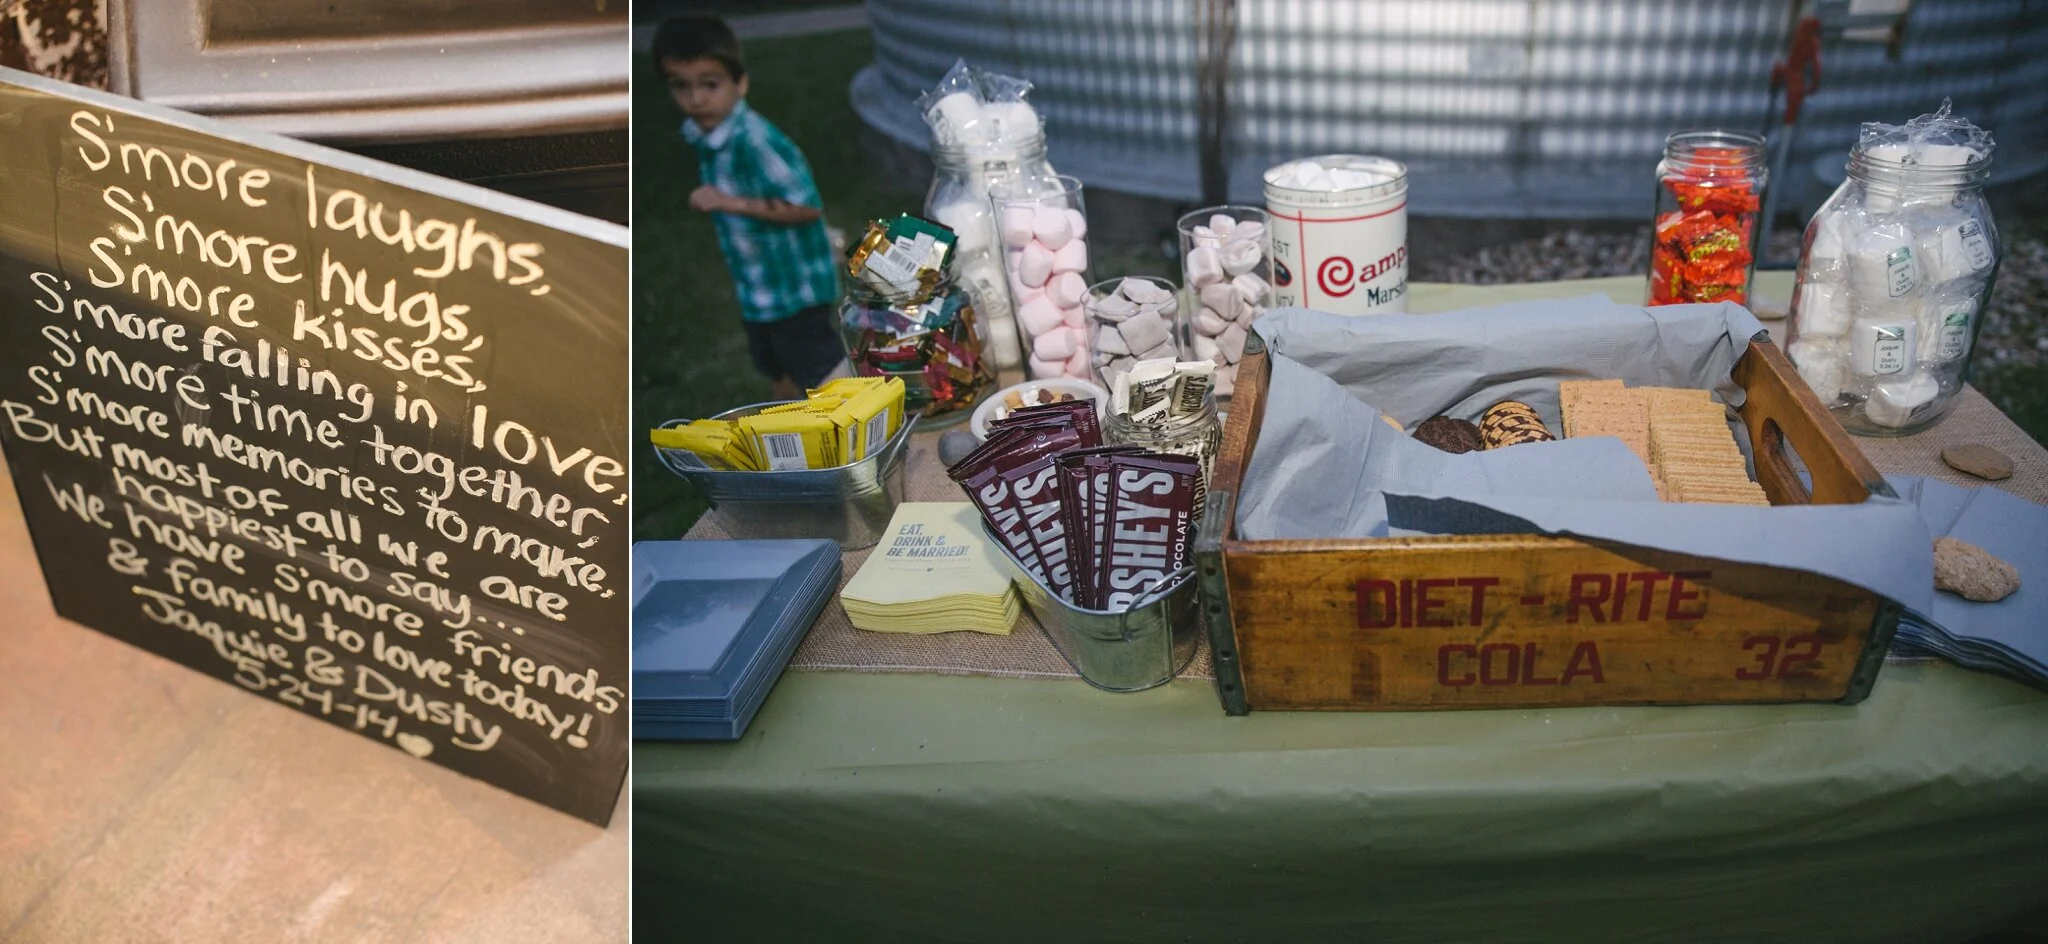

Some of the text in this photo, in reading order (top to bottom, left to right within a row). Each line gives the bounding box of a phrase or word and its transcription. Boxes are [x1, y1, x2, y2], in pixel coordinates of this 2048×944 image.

[70, 110, 551, 296] S'more laughs,
[103, 185, 484, 352] S'more hugs,
[1316, 241, 1408, 298] Camp
[88, 237, 487, 394] S'more kisses,
[1366, 276, 1408, 308] Mars
[28, 365, 170, 439] S'more
[182, 422, 405, 517] memories
[417, 490, 468, 543] to
[29, 271, 628, 506] S'more falling in love,
[41, 325, 610, 549] S'more time together,
[1, 399, 569, 621] But most of all we are
[41, 470, 114, 529] We
[123, 502, 246, 575] have
[447, 629, 625, 714] friends
[112, 466, 526, 637] happiest to say...
[886, 545, 969, 557] BE MARRIED!
[893, 535, 946, 547] DRINK &
[899, 523, 924, 536] EAT,
[107, 537, 593, 749] & family to love today!
[132, 585, 502, 751] Jaquie & Dusty
[1356, 576, 1500, 630] DIET
[1566, 570, 1713, 625] RITE
[1437, 639, 1606, 688] COLA
[1735, 632, 1825, 682] 32
